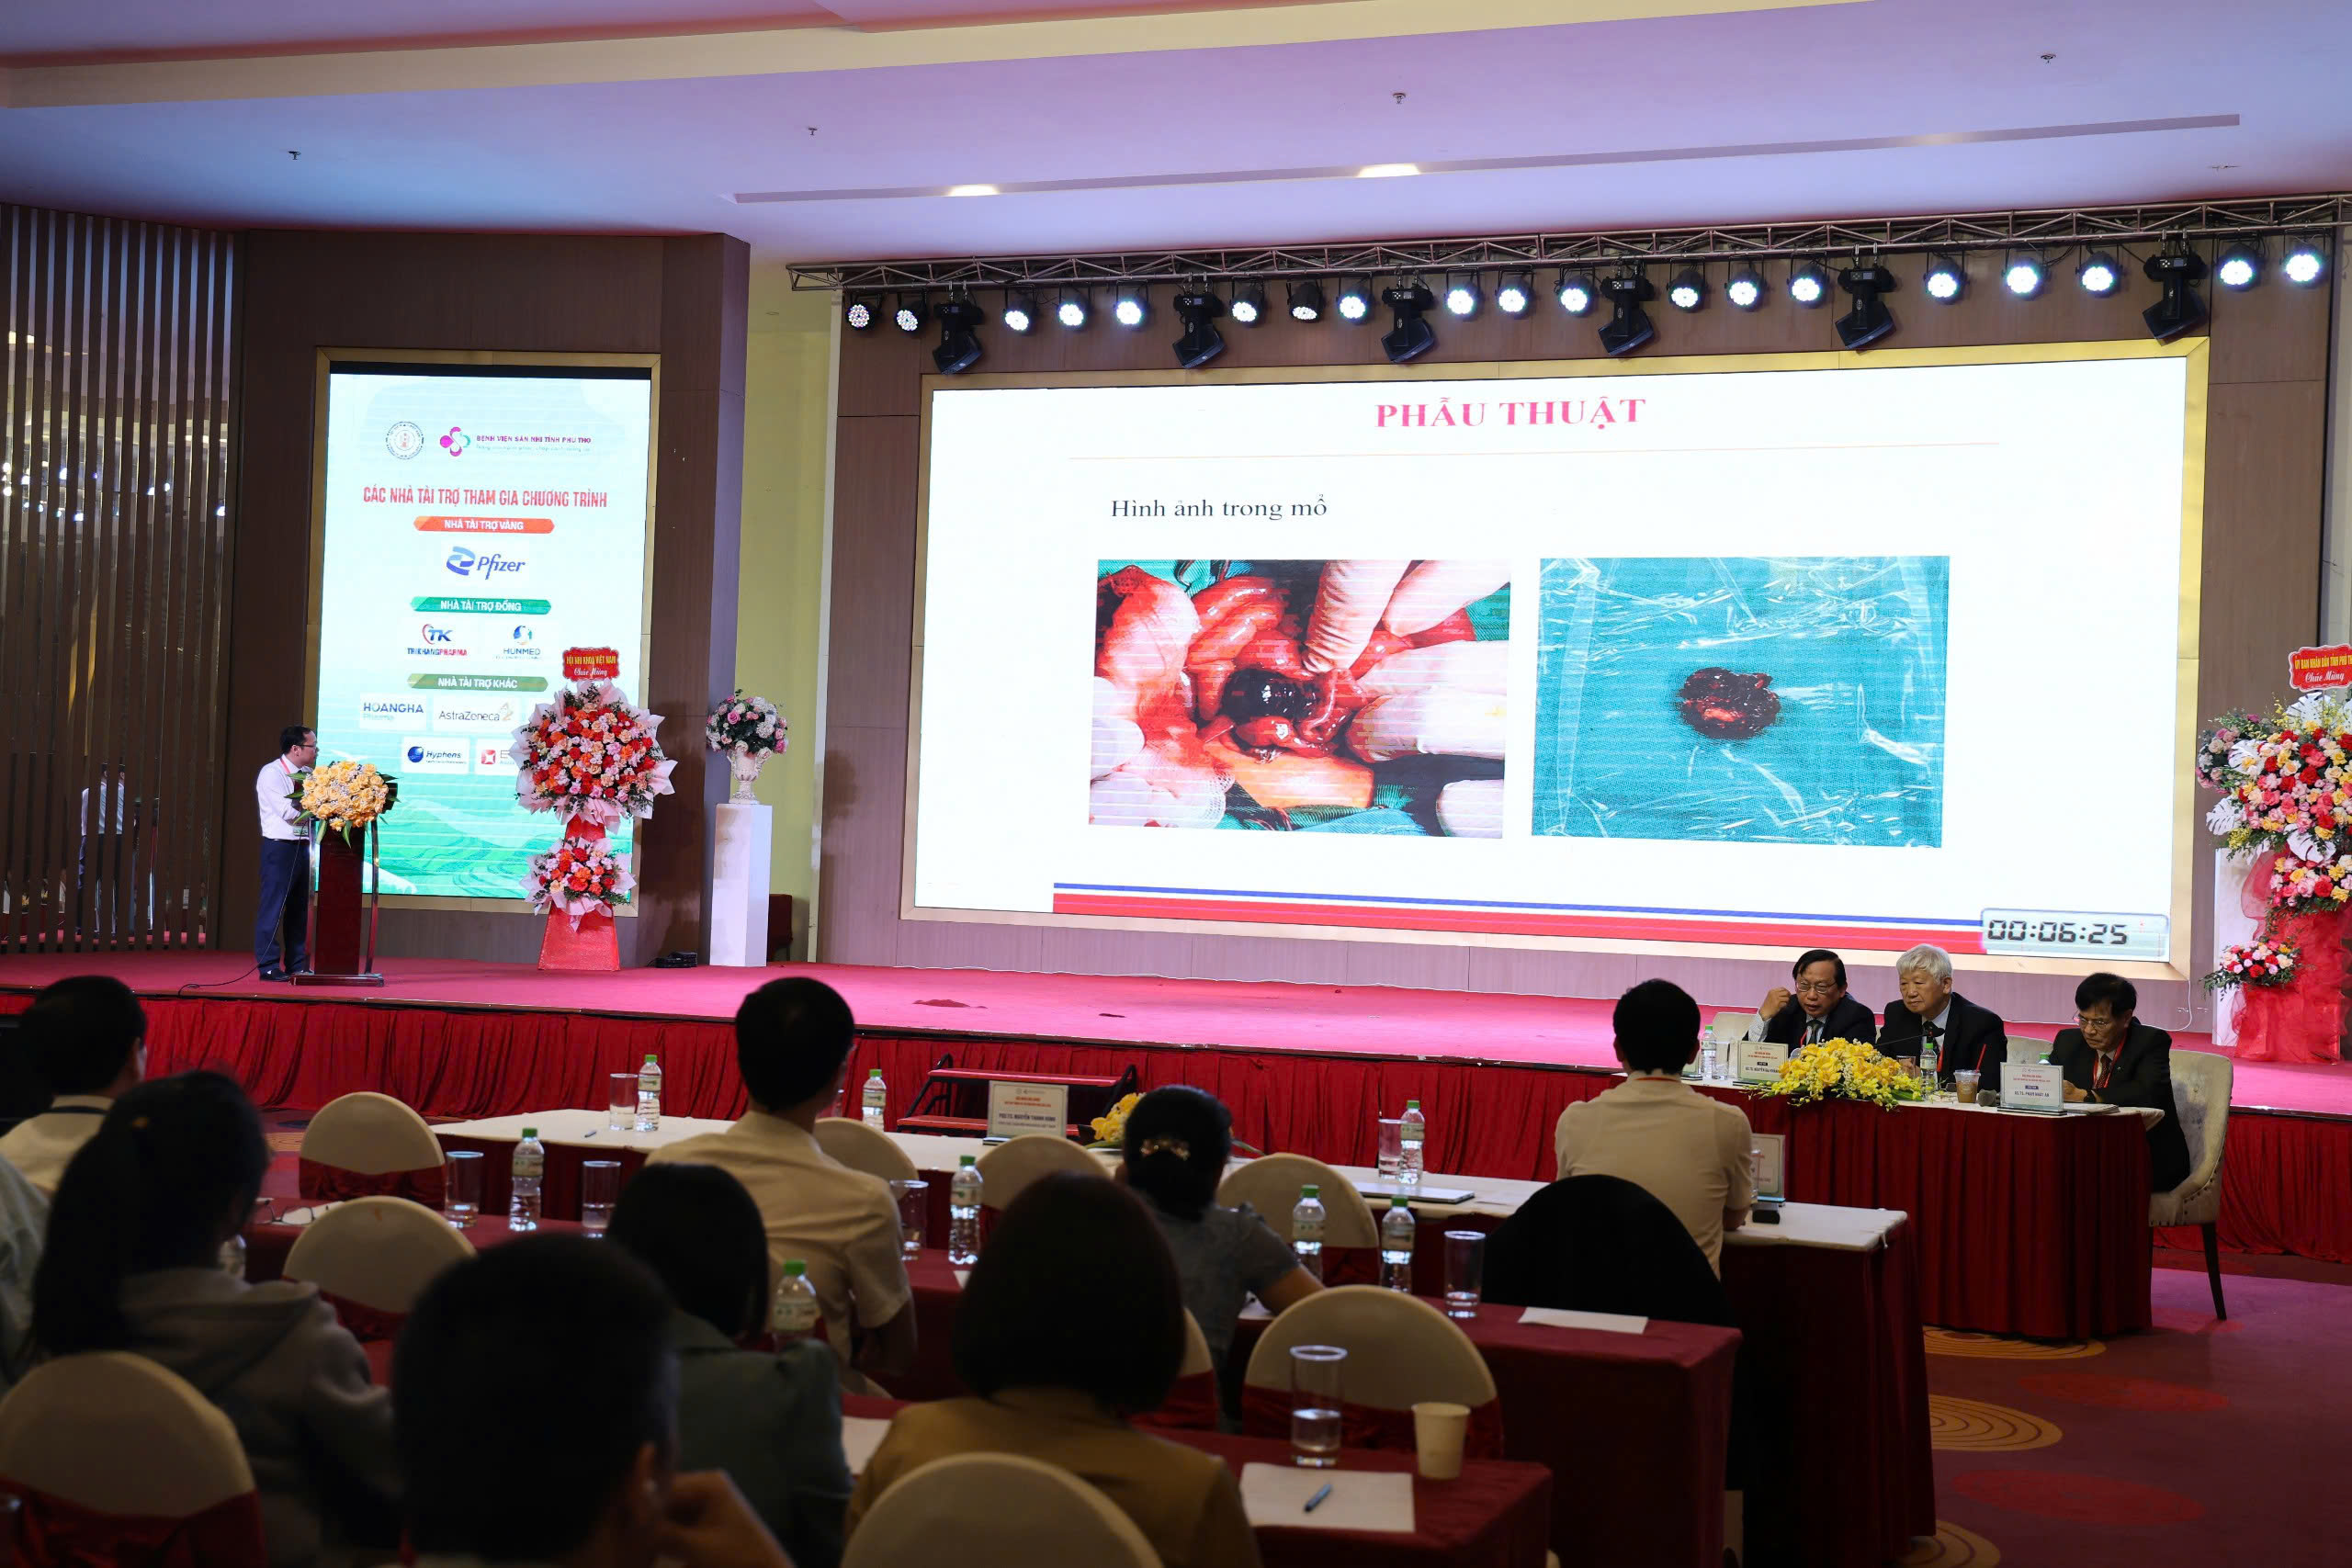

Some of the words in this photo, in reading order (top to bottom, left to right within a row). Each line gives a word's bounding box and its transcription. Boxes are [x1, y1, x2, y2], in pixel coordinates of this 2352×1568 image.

[1374, 397, 1488, 427] PHẪU
[1499, 396, 1646, 430] THUẬT
[363, 484, 387, 503] CÁC
[390, 485, 413, 503] NHÀ
[417, 485, 435, 504] TÀI
[438, 488, 460, 508] TRỢ
[463, 490, 496, 505] THAM
[499, 490, 519, 506] GIA
[522, 490, 570, 507] CHƯƠNG
[573, 489, 607, 508] TRÌNH
[1111, 500, 1166, 517] Hình
[1174, 499, 1214, 517] ảnh
[1223, 502, 1283, 521] trong
[1291, 493, 1328, 516] mổ
[445, 518, 464, 529] NHÀ
[465, 519, 479, 530] TÀI
[481, 521, 497, 531] TRỢ
[497, 520, 525, 531] VÀNG
[477, 553, 526, 580] Pfizer
[441, 599, 459, 610] NHÀ
[460, 599, 474, 611] TÀI
[476, 601, 494, 613] TRỢ
[503, 648, 540, 656] HUNMED
[438, 675, 457, 687] NHÀ
[458, 676, 471, 687] TÀI
[473, 678, 492, 689] TRỢ
[492, 677, 518, 689] KHÁC
[363, 703, 424, 713] HOANGHA
[438, 710, 501, 722] AstraZeneca
[425, 750, 462, 760] Hyphens
[1987, 919, 2128, 945] 00:06:25
